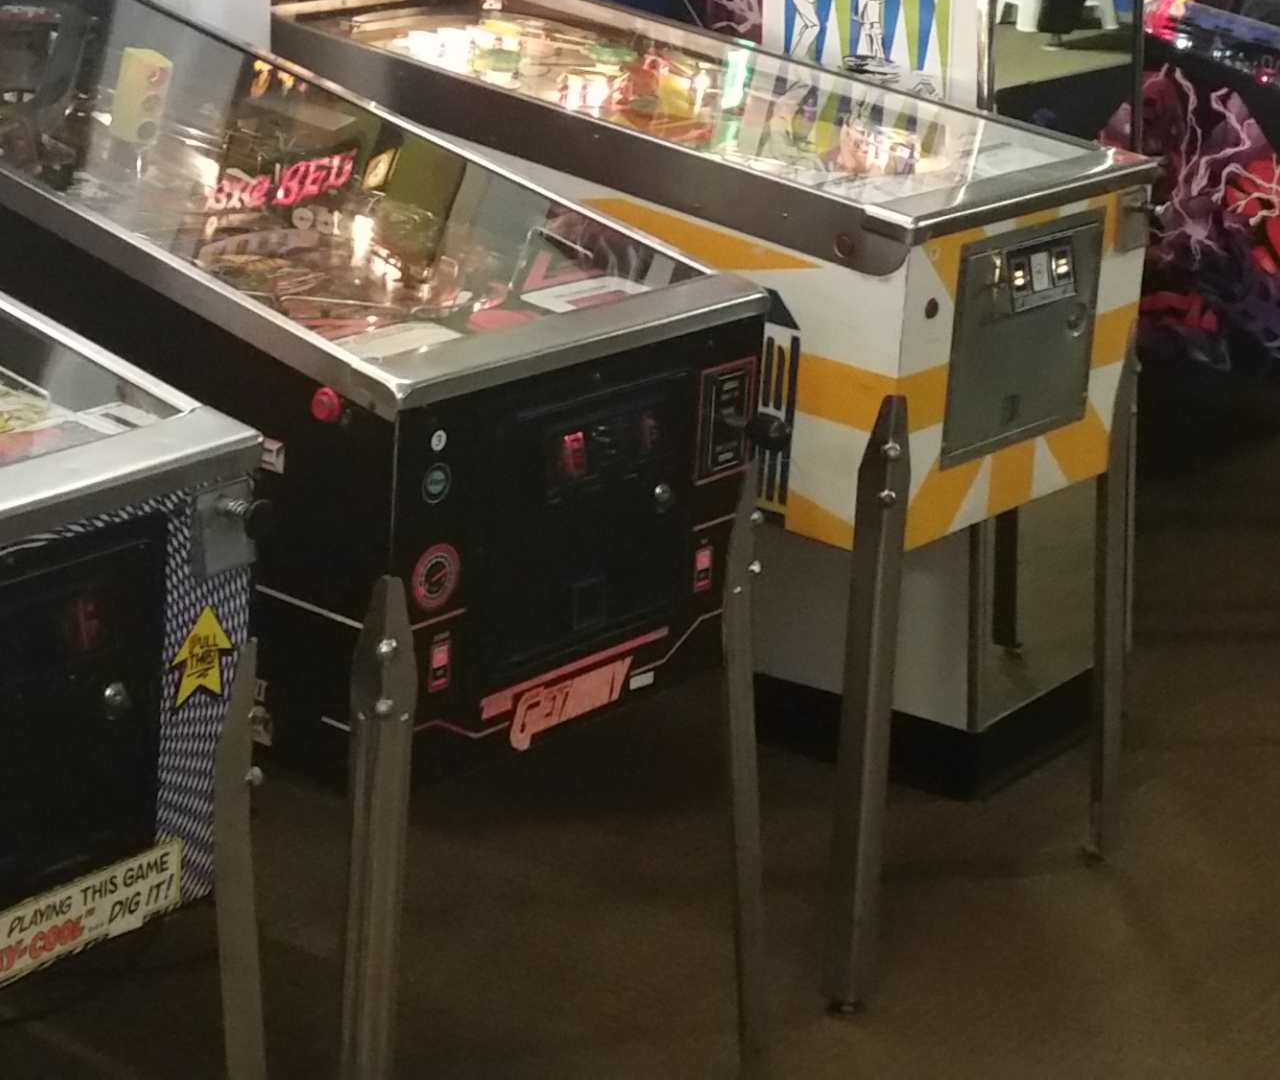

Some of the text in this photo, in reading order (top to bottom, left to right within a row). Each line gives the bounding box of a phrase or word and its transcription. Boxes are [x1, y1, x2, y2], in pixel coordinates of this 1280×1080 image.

[188, 631, 219, 656] PULL
[7, 894, 73, 938] PLAYING
[79, 874, 119, 907] THIS
[122, 852, 171, 888] GAME
[108, 891, 142, 925] DIG
[146, 873, 175, 905] IT!
